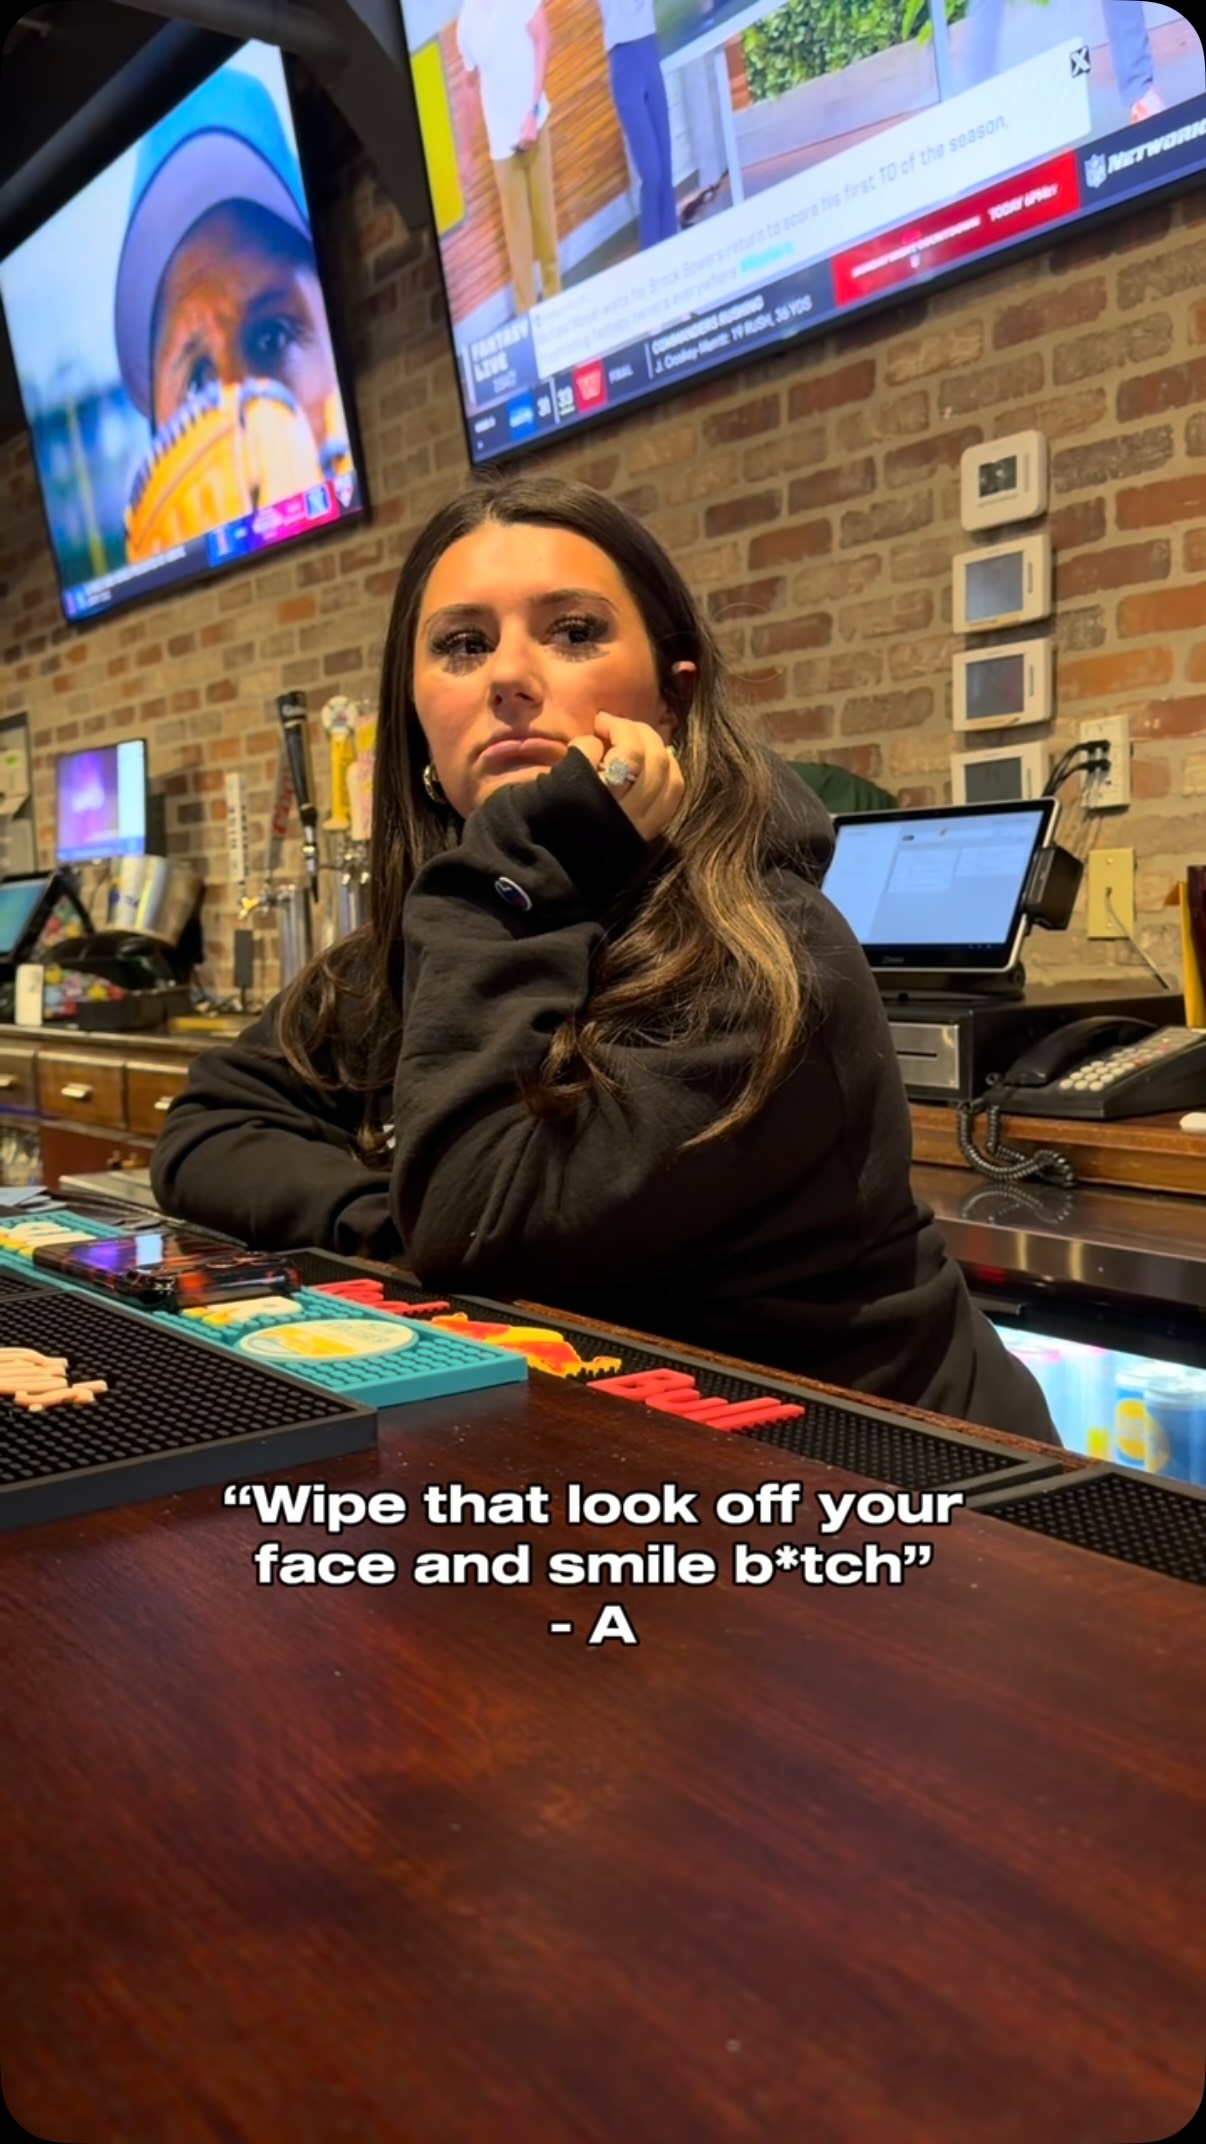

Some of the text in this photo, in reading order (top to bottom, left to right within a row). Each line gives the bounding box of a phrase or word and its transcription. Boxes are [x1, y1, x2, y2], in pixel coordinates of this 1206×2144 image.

[766, 220, 781, 238] to
[783, 203, 819, 231] score
[821, 192, 842, 212] his
[843, 175, 876, 201] first
[878, 162, 898, 184] TD
[900, 152, 915, 175] of
[919, 143, 946, 166] the
[474, 350, 509, 383] LIVE
